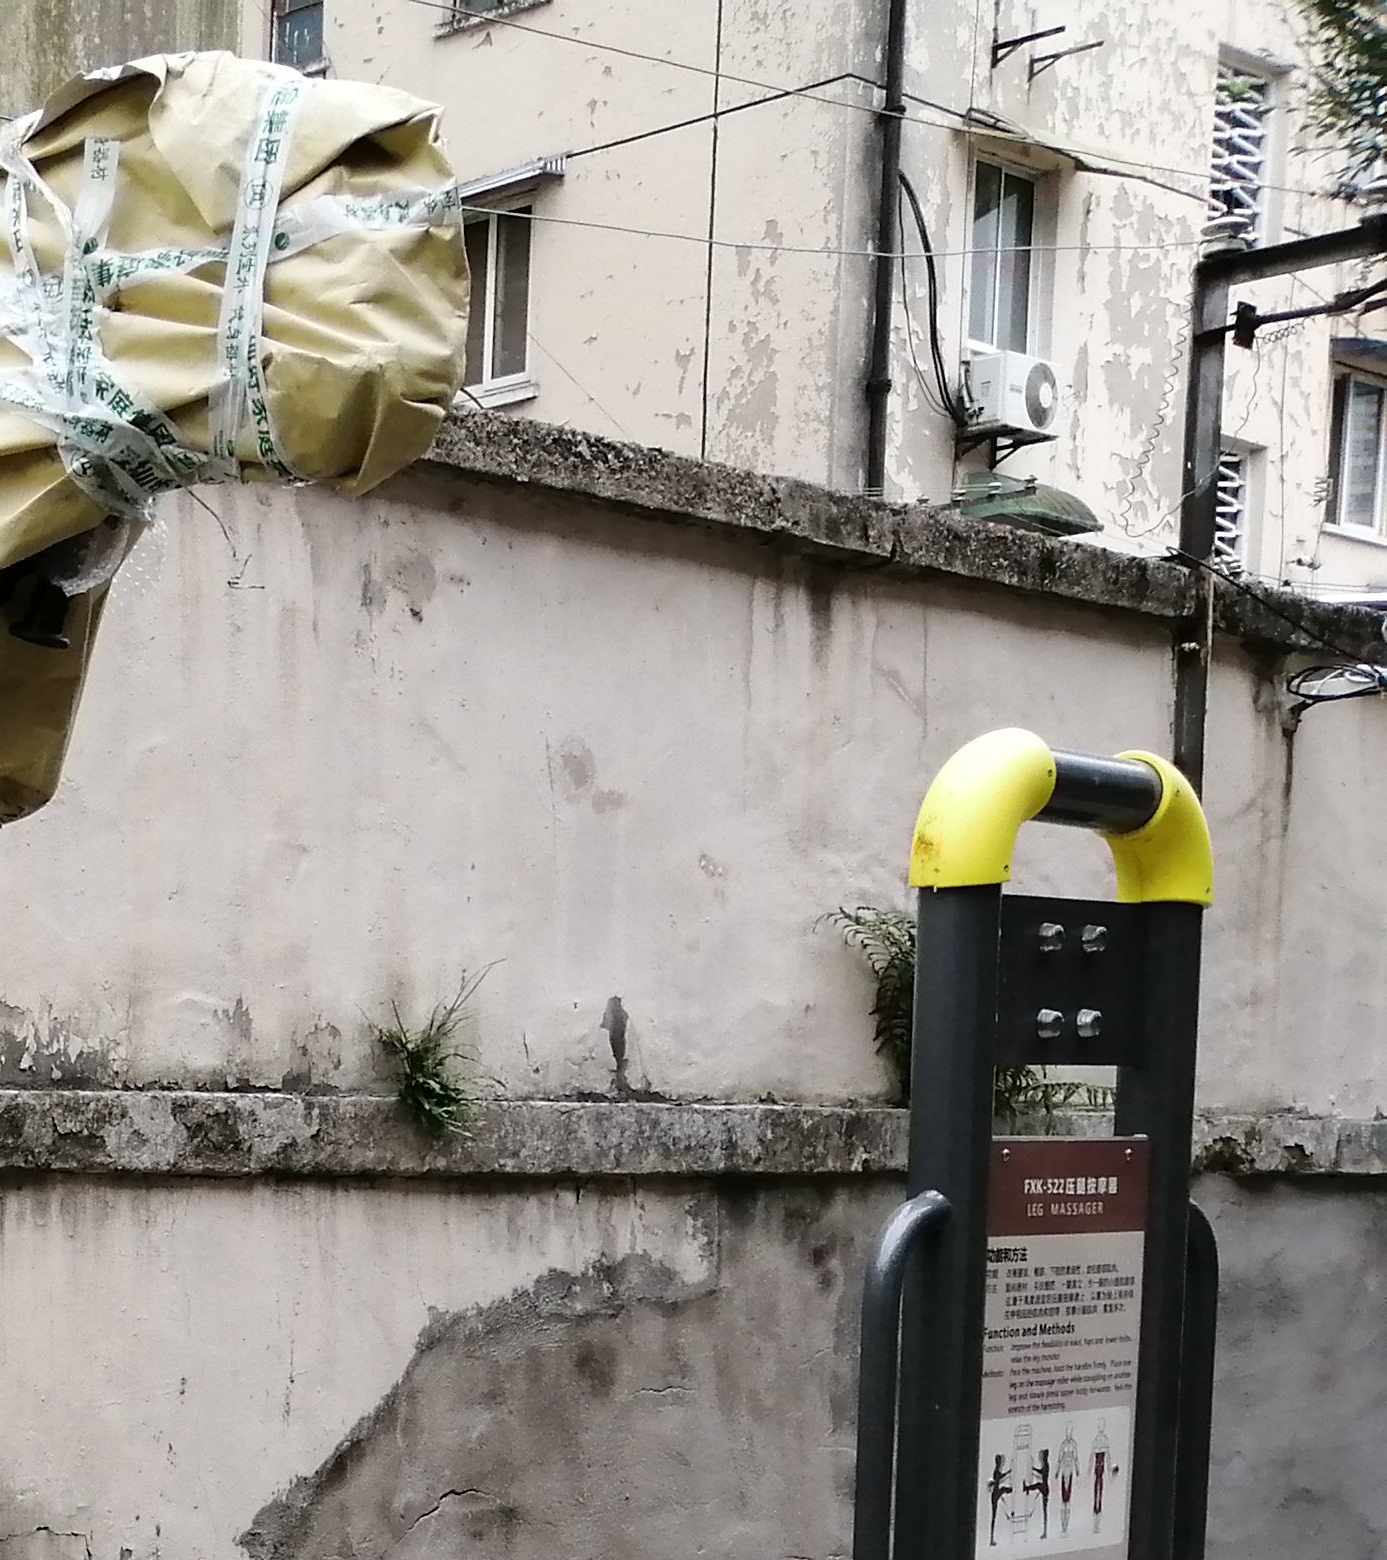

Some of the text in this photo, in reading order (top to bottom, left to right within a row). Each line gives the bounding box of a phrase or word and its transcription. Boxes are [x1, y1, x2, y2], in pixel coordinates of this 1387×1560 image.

[1027, 1201, 1104, 1217] LEG MASSAGER
[1021, 1324, 1038, 1337] and
[1039, 1321, 1075, 1335] Methods
